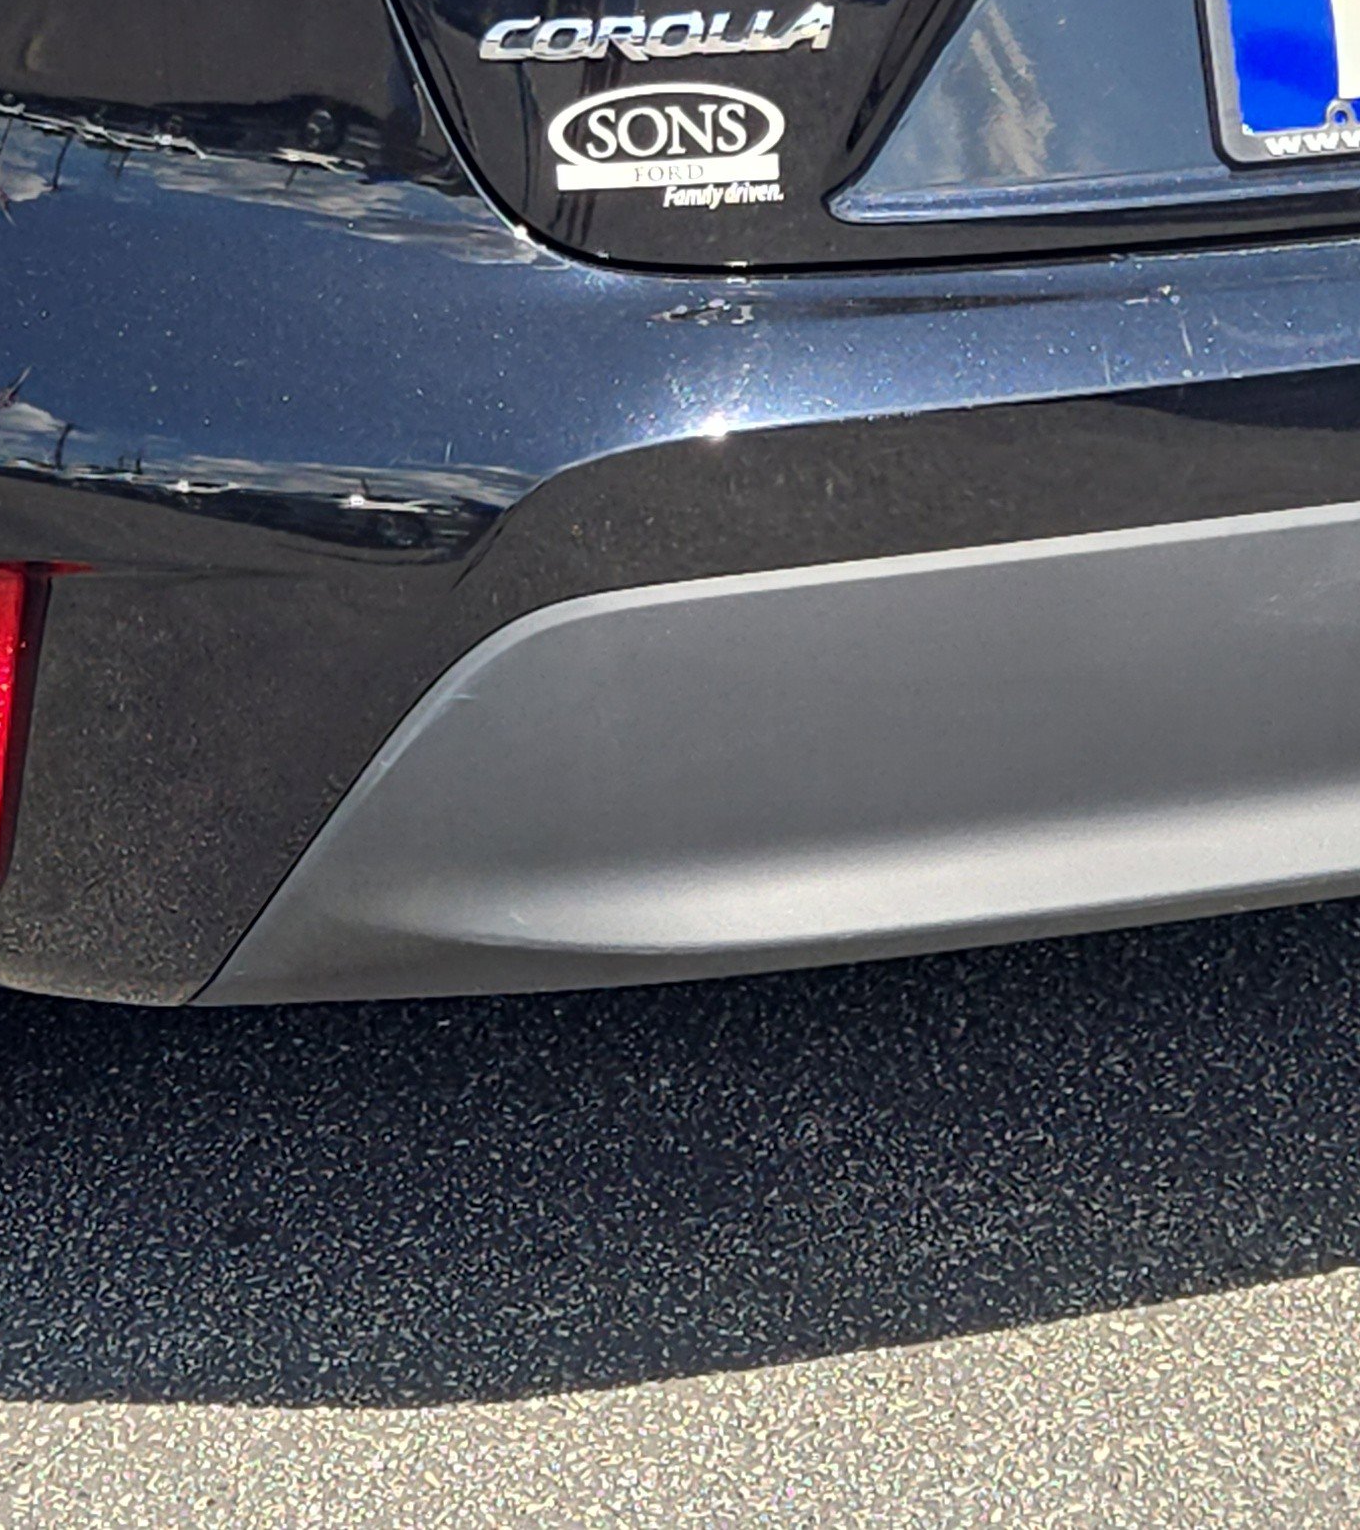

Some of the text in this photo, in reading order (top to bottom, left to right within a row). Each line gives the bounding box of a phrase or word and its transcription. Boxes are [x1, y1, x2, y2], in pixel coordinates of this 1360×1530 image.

[479, 2, 835, 61] COROLLA
[585, 102, 748, 160] SONS
[634, 163, 704, 183] FORD
[663, 181, 785, 209] Family driven.
